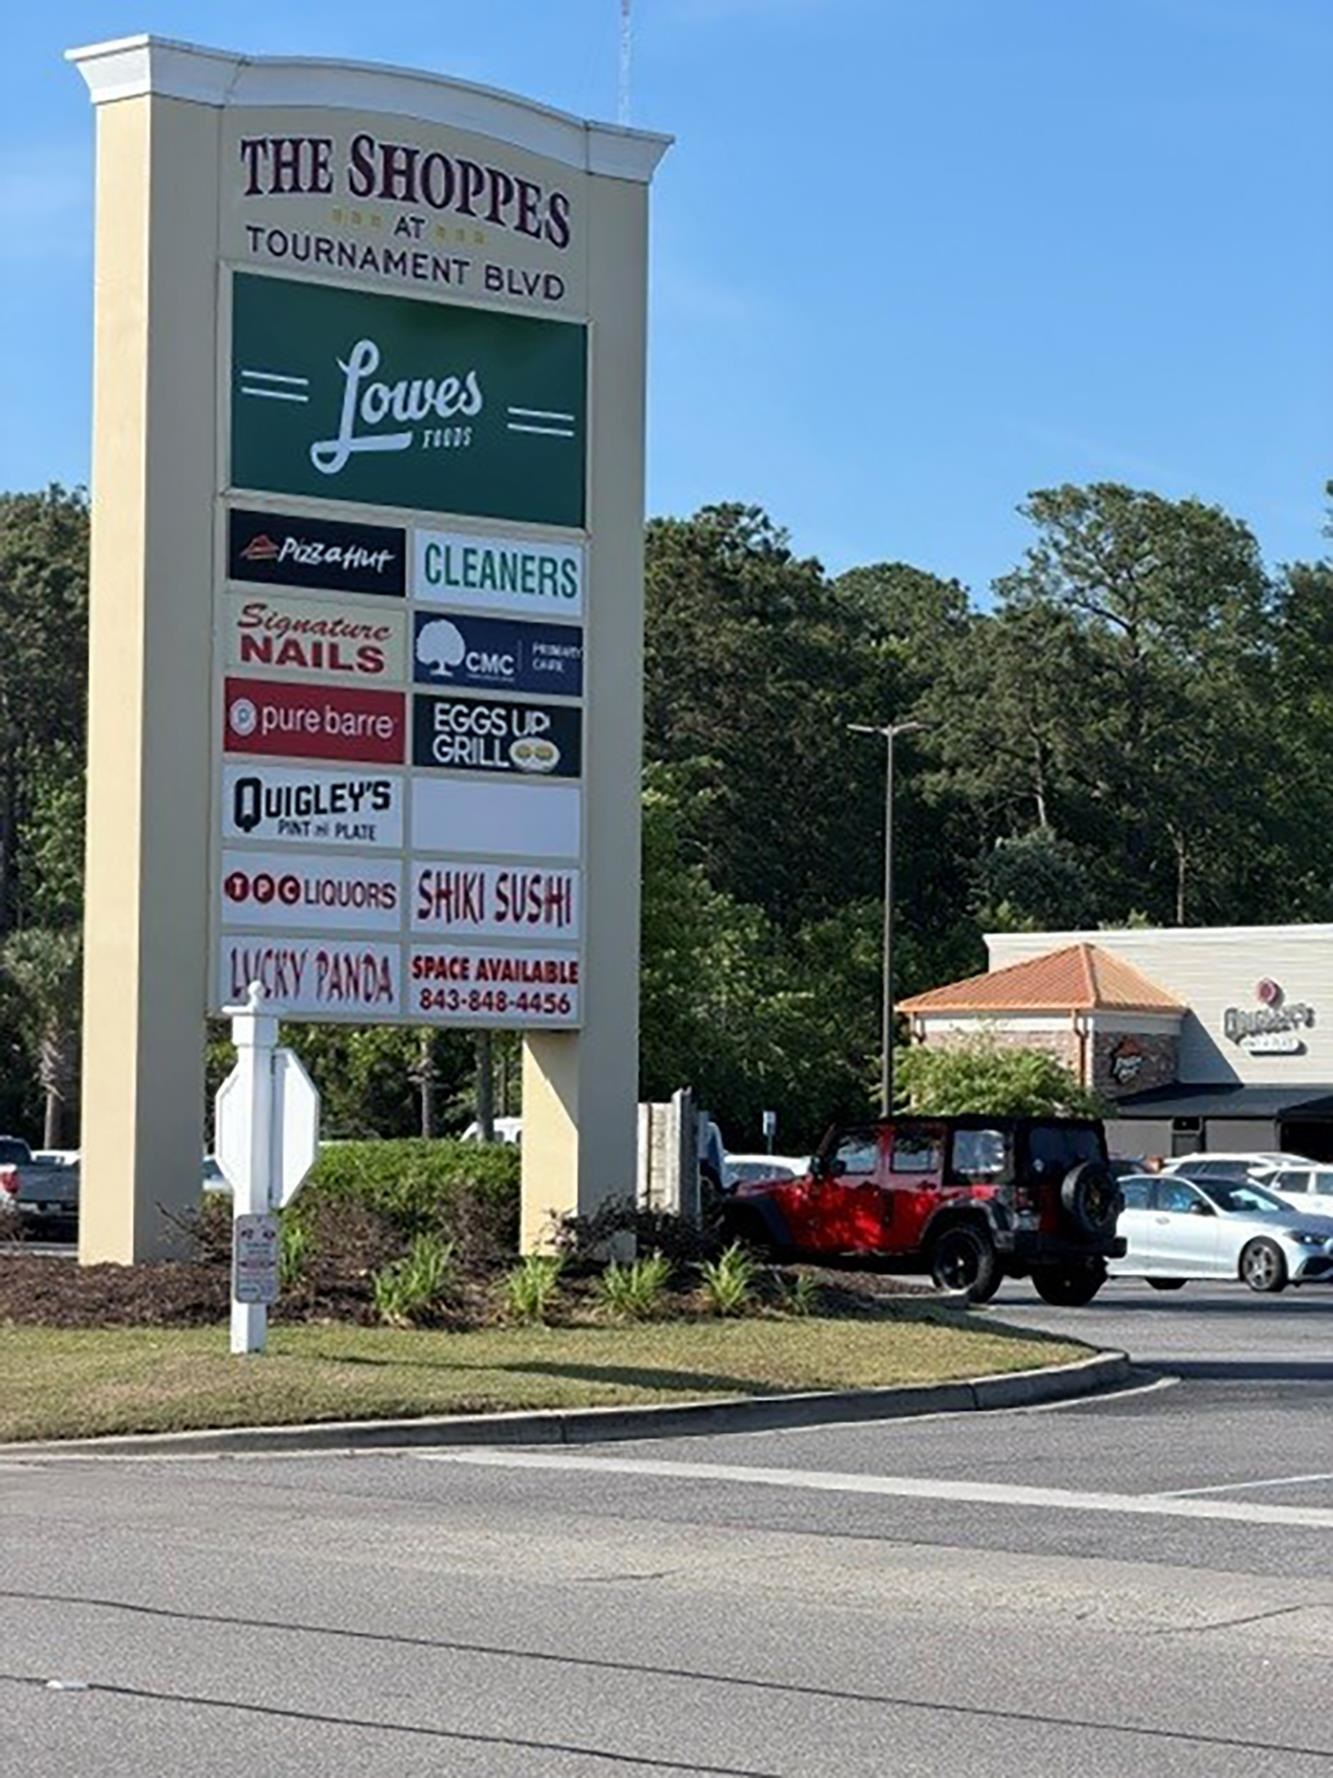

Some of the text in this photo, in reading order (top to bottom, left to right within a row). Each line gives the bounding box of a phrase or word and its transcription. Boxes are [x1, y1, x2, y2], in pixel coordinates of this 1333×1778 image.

[240, 134, 571, 249] THE SHOPPES
[394, 216, 426, 239] AT
[246, 225, 565, 301] TOURNAMENT BLVD
[310, 339, 483, 475] Lowes
[423, 427, 473, 449] FOODS
[425, 543, 577, 598] CLEANERS
[238, 603, 393, 641] Signature
[240, 635, 386, 674] NAILS
[465, 652, 515, 675] CMC
[261, 704, 393, 738] pure barre
[434, 703, 551, 737] EGGS UP
[433, 736, 511, 768] GRILL
[234, 777, 391, 833] QUIGLEY'S
[278, 819, 311, 836] PINT
[335, 822, 377, 841] PLATE
[304, 878, 397, 910] LIQUORS
[418, 870, 572, 927] SHIKI SUSHI
[231, 947, 394, 1003] LUCKY PANDA
[412, 956, 579, 985] SPACE AVAILABLE
[419, 988, 571, 1015] 843-848-4456
